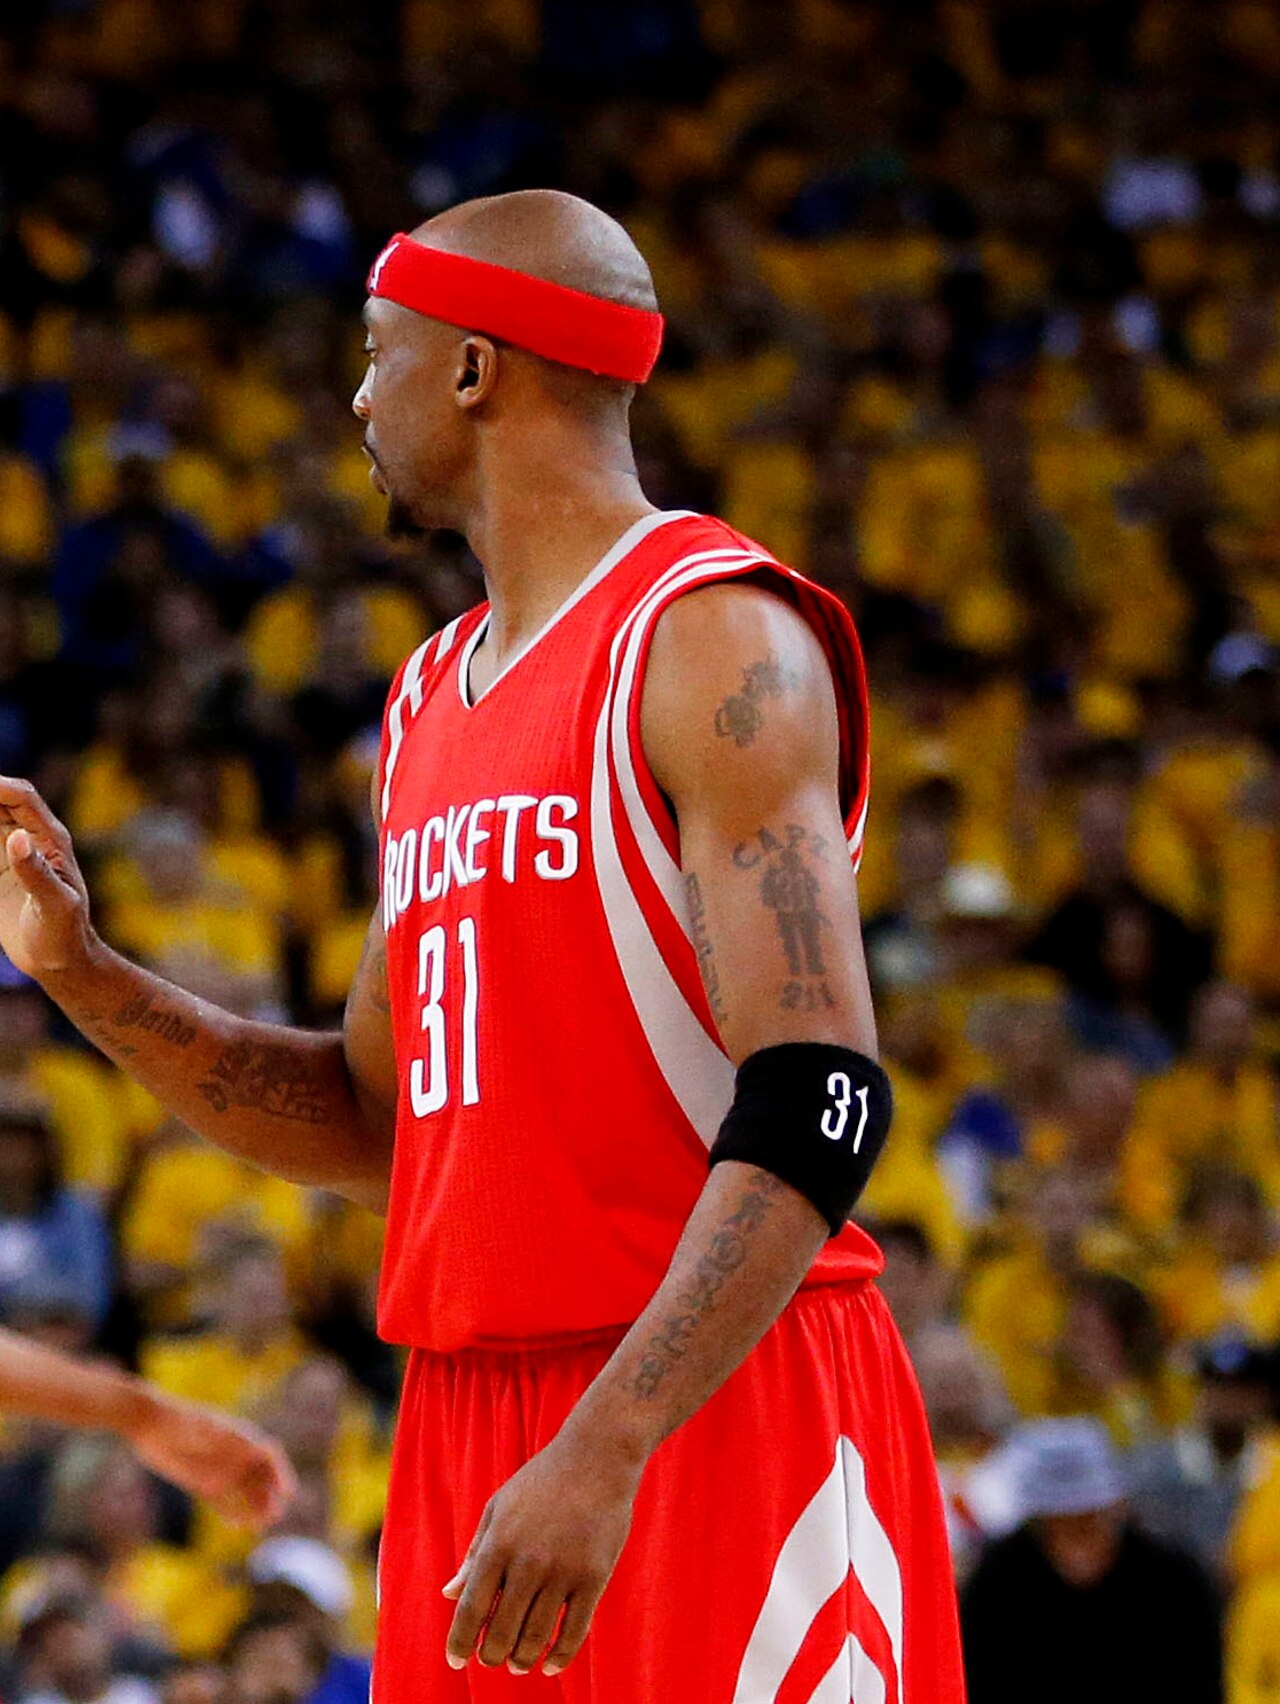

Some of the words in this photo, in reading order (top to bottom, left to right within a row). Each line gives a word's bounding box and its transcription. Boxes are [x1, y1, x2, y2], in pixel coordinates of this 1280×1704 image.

[382, 794, 579, 933] ROCKETS
[410, 917, 481, 1119] 31
[820, 1071, 869, 1155] 31
